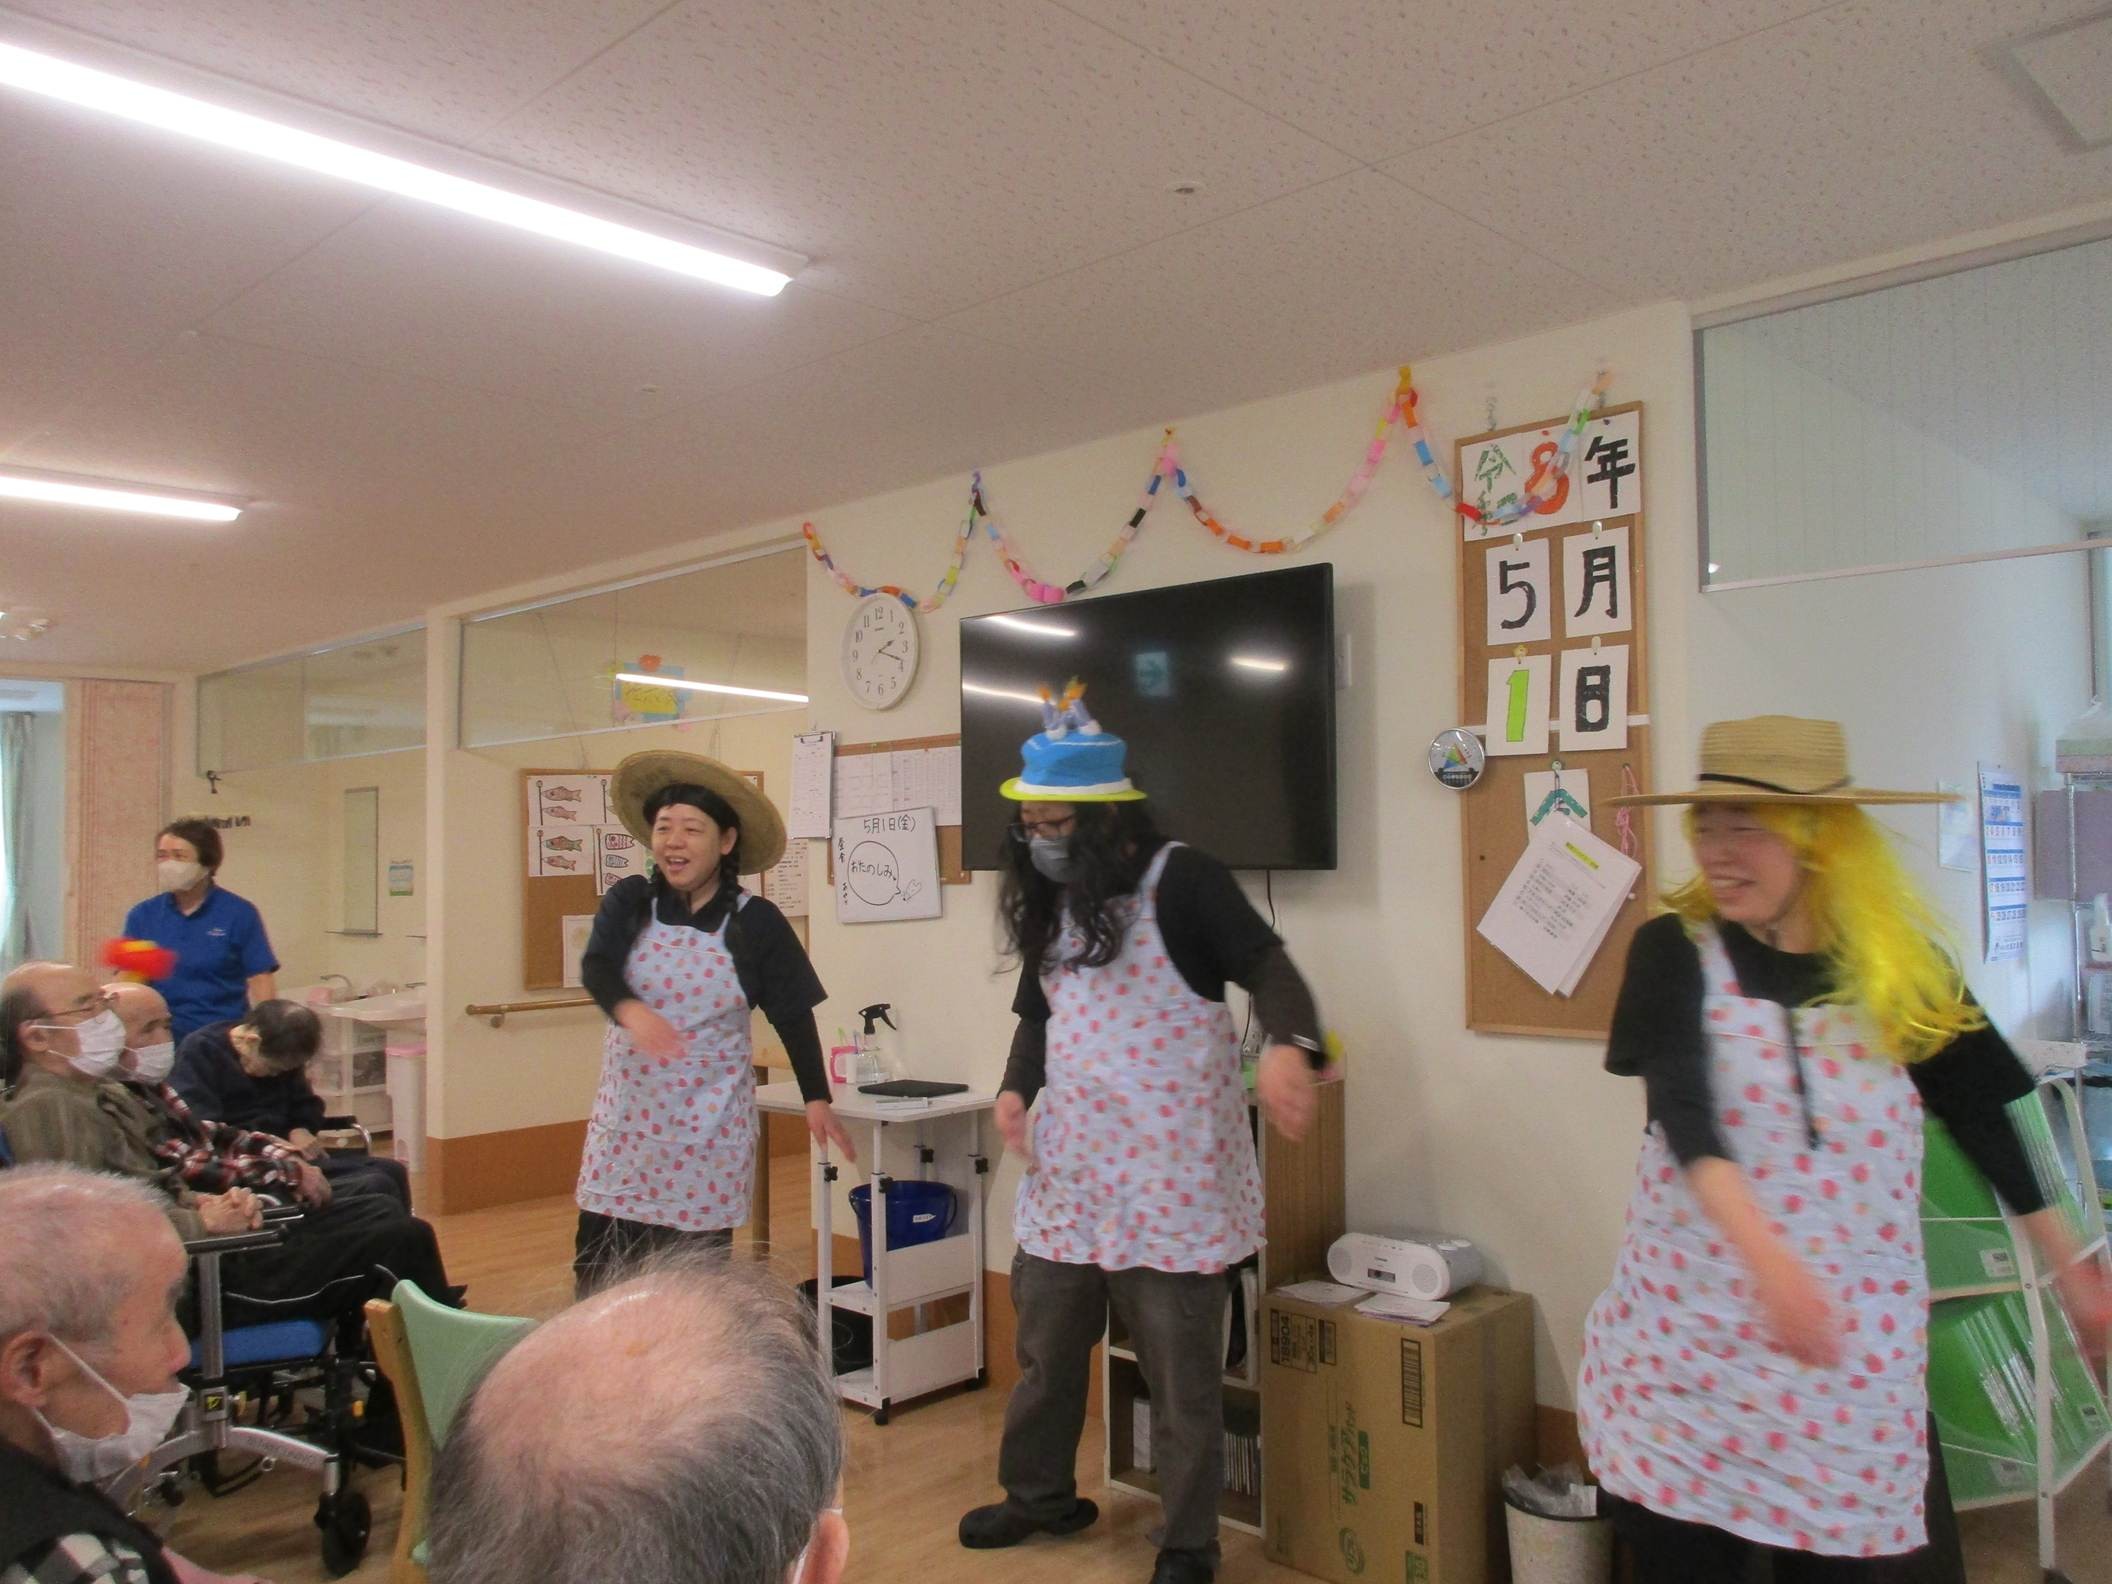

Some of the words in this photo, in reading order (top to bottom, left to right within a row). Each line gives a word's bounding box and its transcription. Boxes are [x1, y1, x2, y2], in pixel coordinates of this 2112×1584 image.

[874, 606, 884, 621] 12
[863, 615, 870, 628] 11
[898, 622, 905, 635] 2
[855, 629, 863, 643] 10
[902, 640, 909, 654] 3
[852, 650, 859, 663] 9
[856, 667, 863, 681] 8
[865, 680, 872, 694] 7
[890, 676, 897, 689] 5
[877, 683, 884, 696] 6
